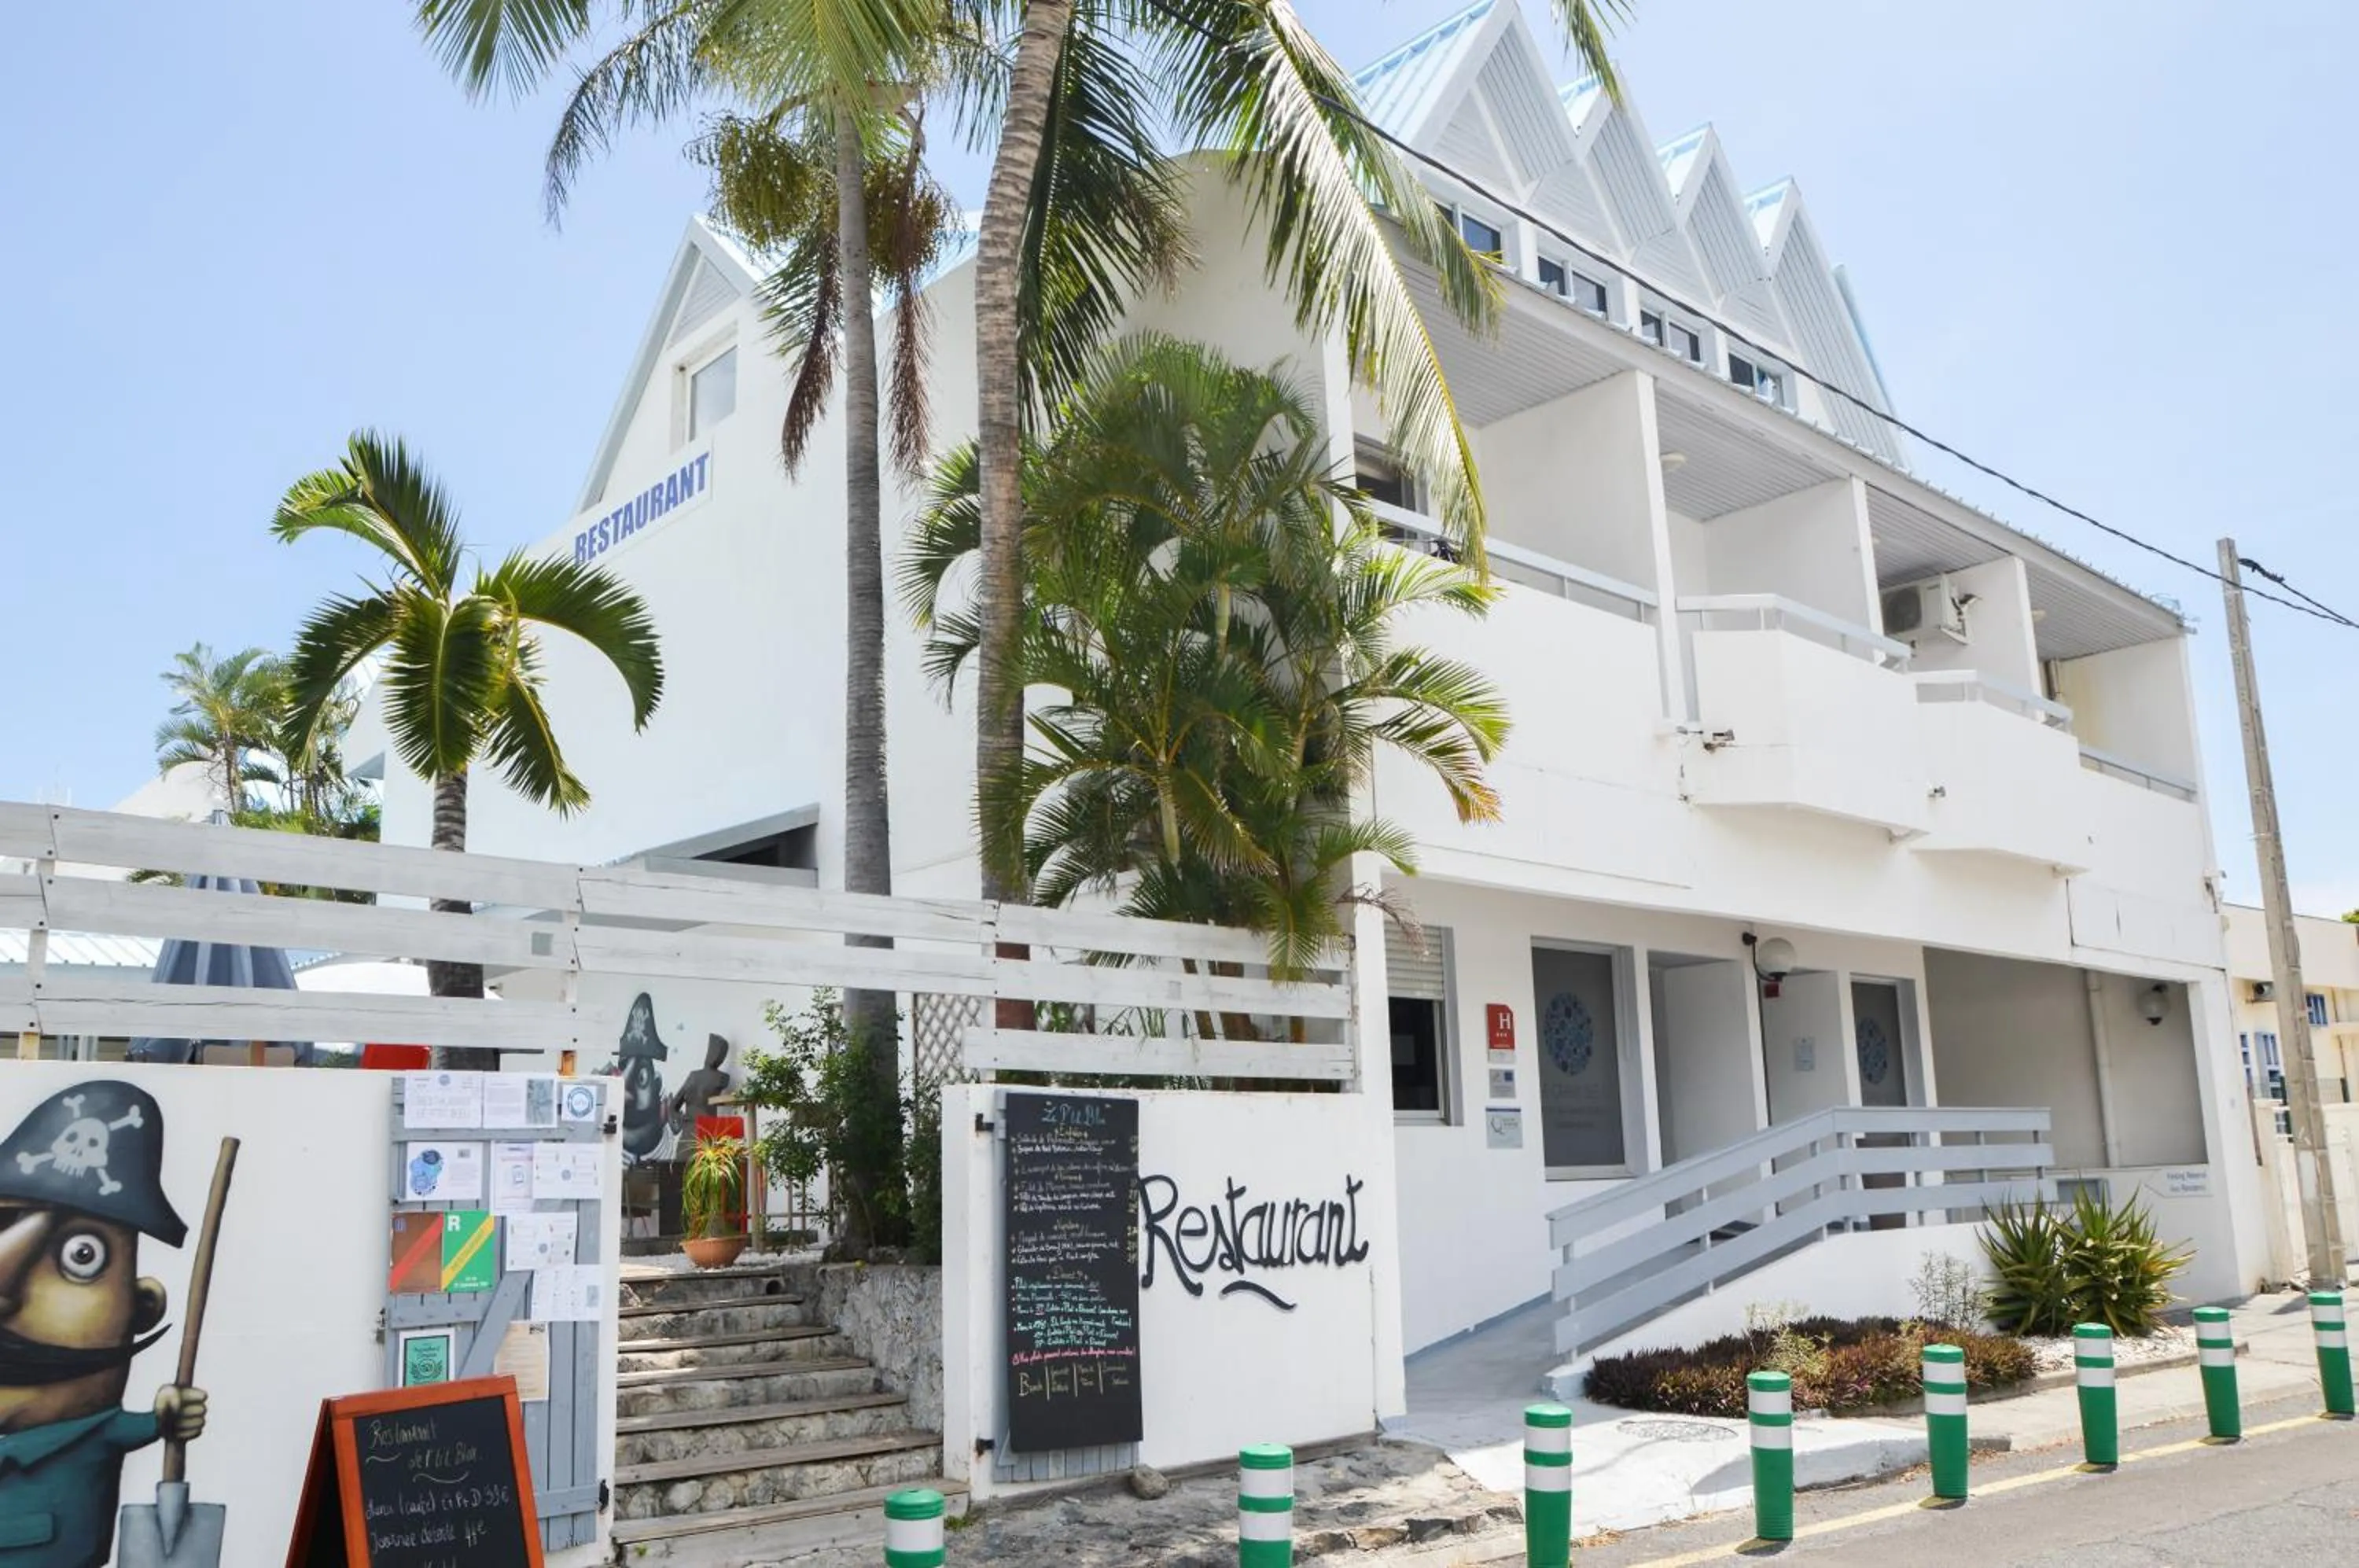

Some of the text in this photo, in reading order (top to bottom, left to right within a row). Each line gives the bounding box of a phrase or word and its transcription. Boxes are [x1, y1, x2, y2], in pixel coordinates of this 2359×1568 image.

[575, 452, 709, 565] RESTAURANT
[1497, 1012, 1511, 1030] H
[447, 1215, 460, 1232] R
[1139, 1173, 1369, 1296] Restaurant
